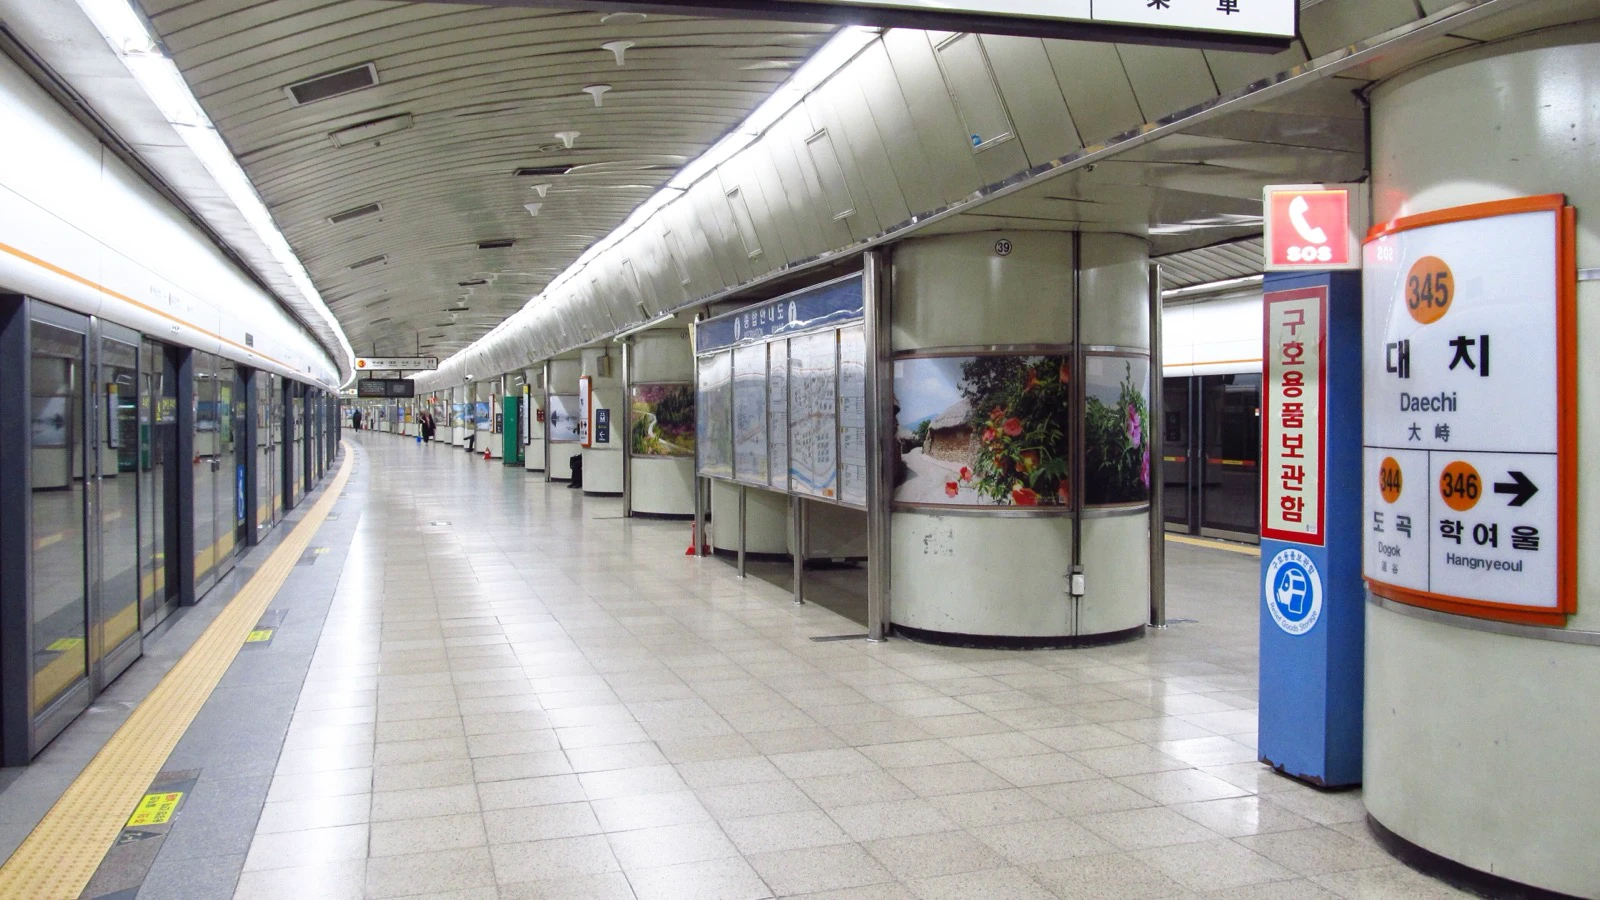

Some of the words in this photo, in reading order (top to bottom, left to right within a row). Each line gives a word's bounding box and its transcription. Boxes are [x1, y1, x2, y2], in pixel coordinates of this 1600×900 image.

[997, 242, 1010, 253] 39
[1286, 245, 1332, 262] SOS
[1408, 272, 1449, 310] 345
[1400, 392, 1457, 412] Daechi
[1280, 308, 1306, 524] 구호용품보관함
[1380, 468, 1401, 493] 344
[1442, 472, 1479, 500] 346
[1378, 541, 1401, 557] Dogok
[1446, 552, 1523, 573] Hangnyeoul
[1269, 601, 1282, 623] Relief
[1281, 619, 1299, 633] Goods
[1299, 610, 1318, 632] Storage
